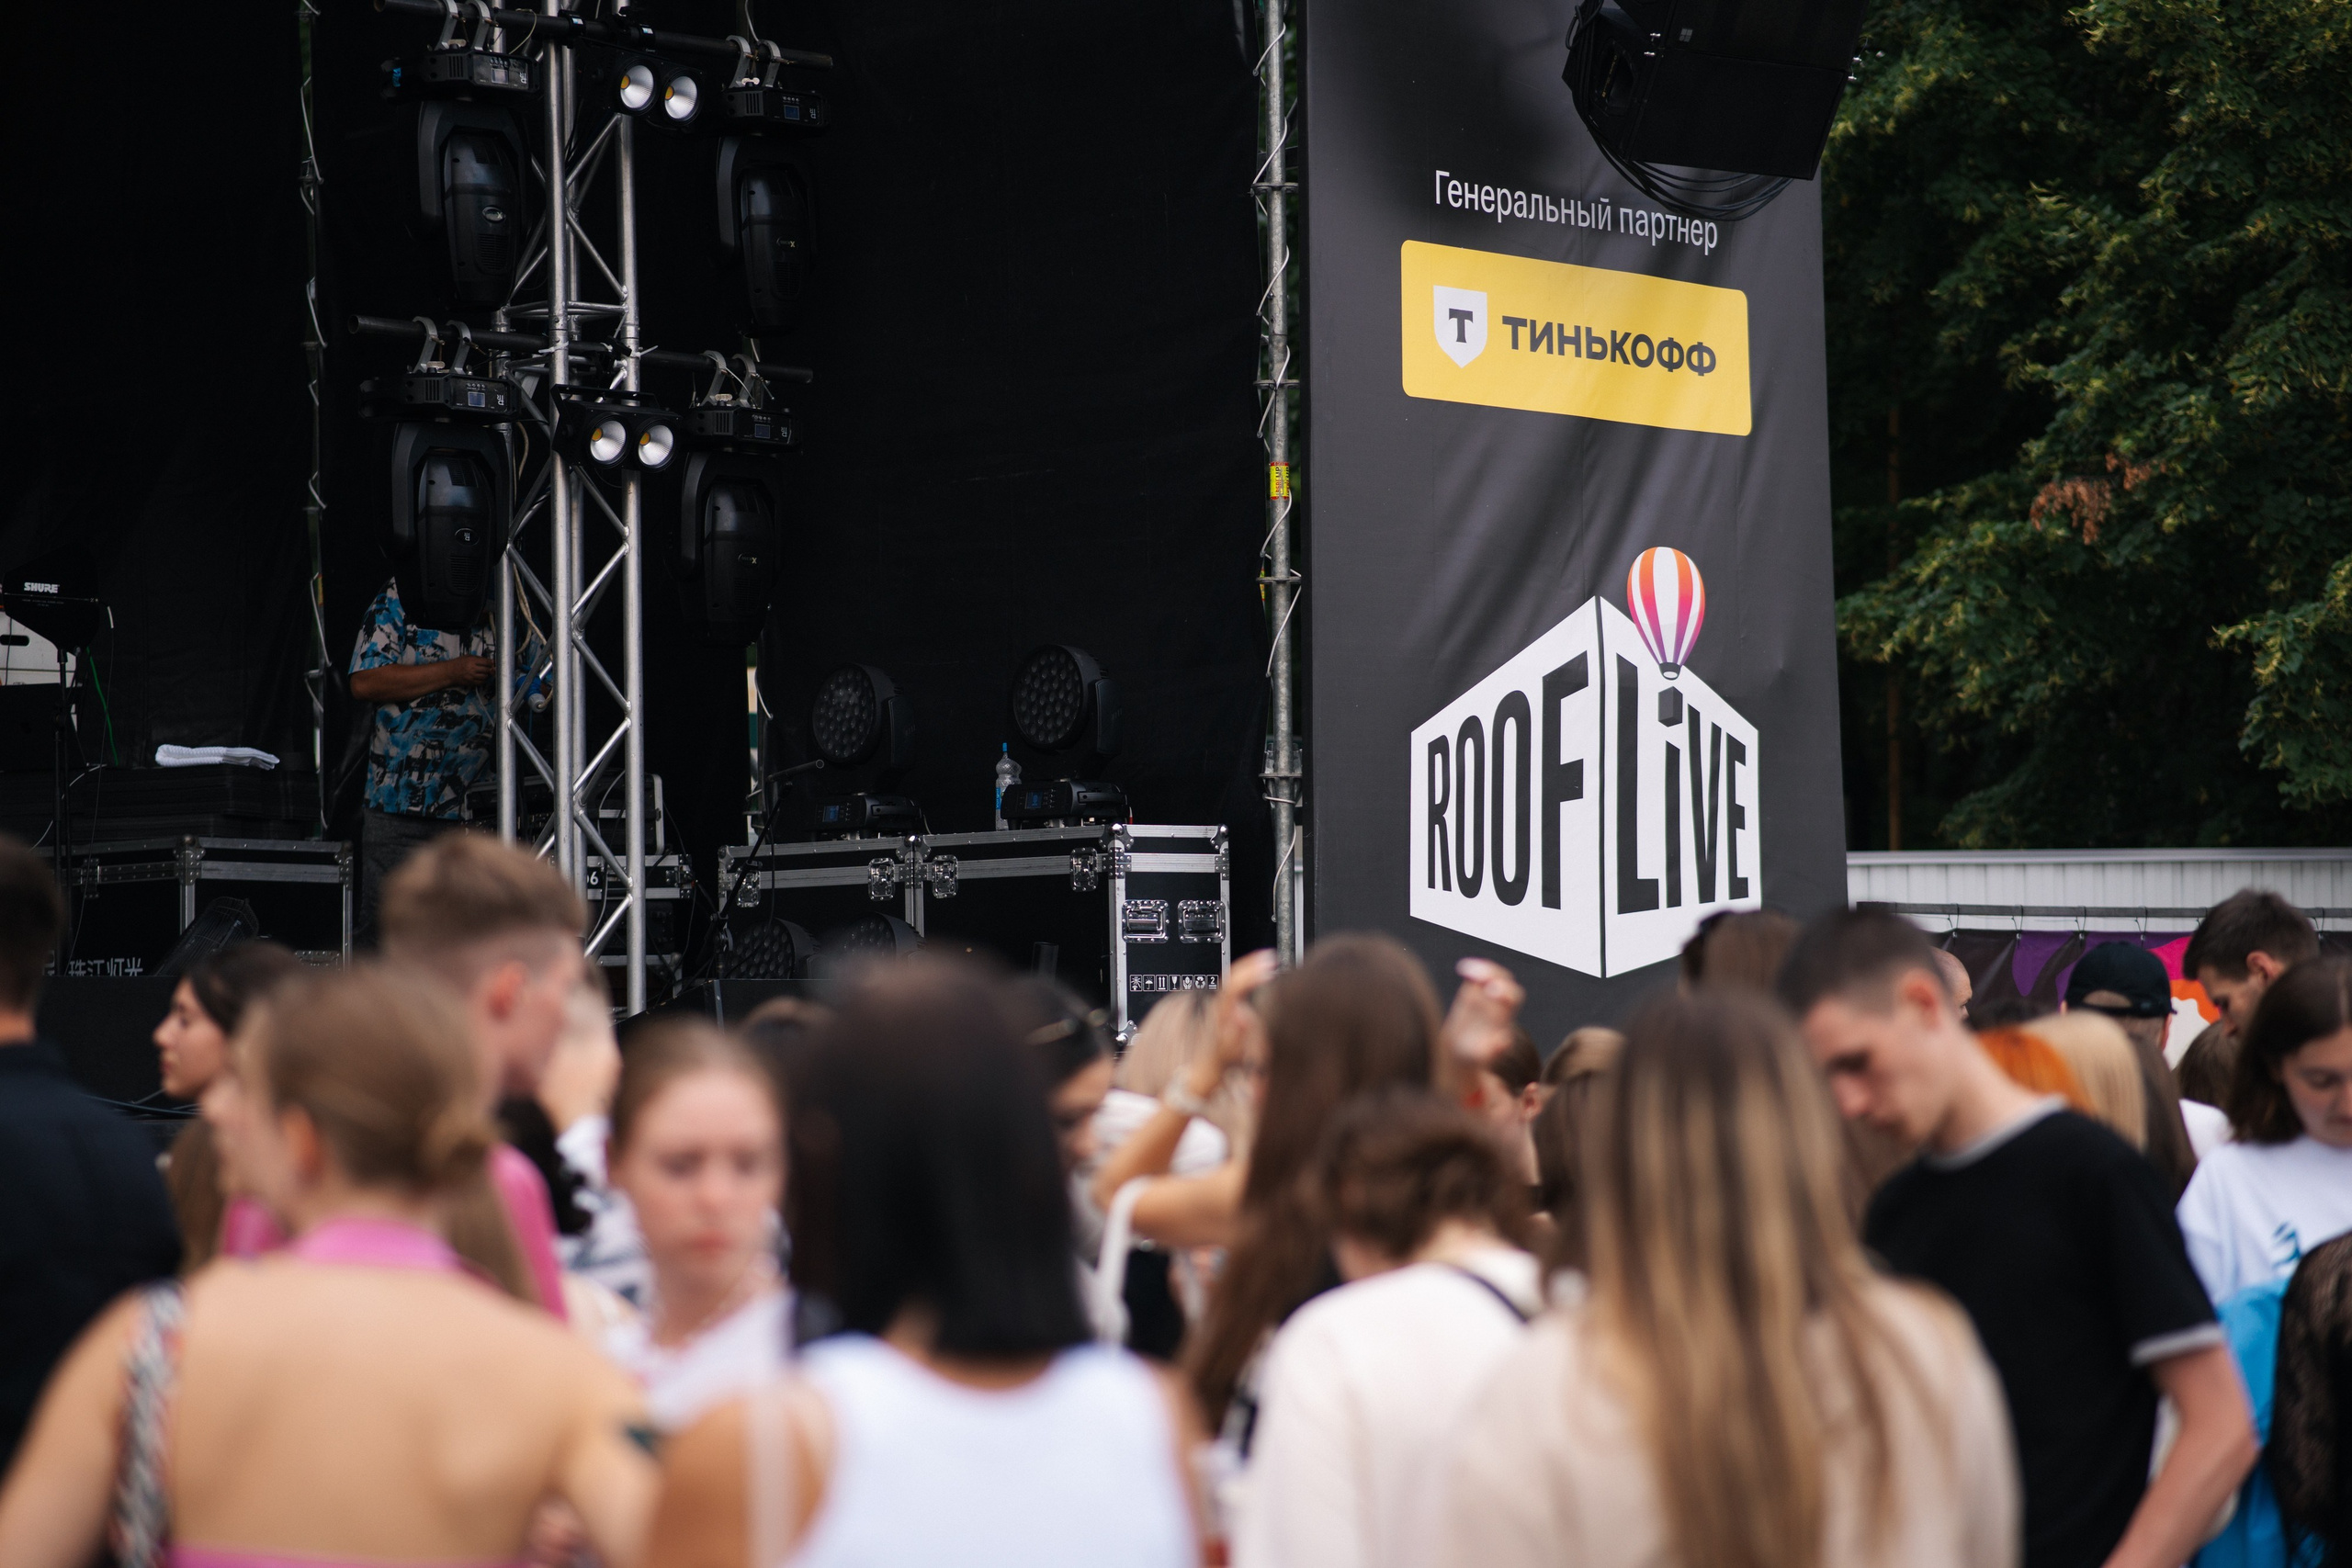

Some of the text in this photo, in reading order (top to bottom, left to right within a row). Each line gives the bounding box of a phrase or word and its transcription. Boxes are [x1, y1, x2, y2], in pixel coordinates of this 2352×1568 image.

[1435, 169, 1718, 256] Генеральный партнер
[1448, 308, 1717, 378] Т ТИНЬКОФФ
[23, 581, 60, 594] SHURE
[1427, 649, 1589, 910] ROOF
[586, 870, 599, 886] 6
